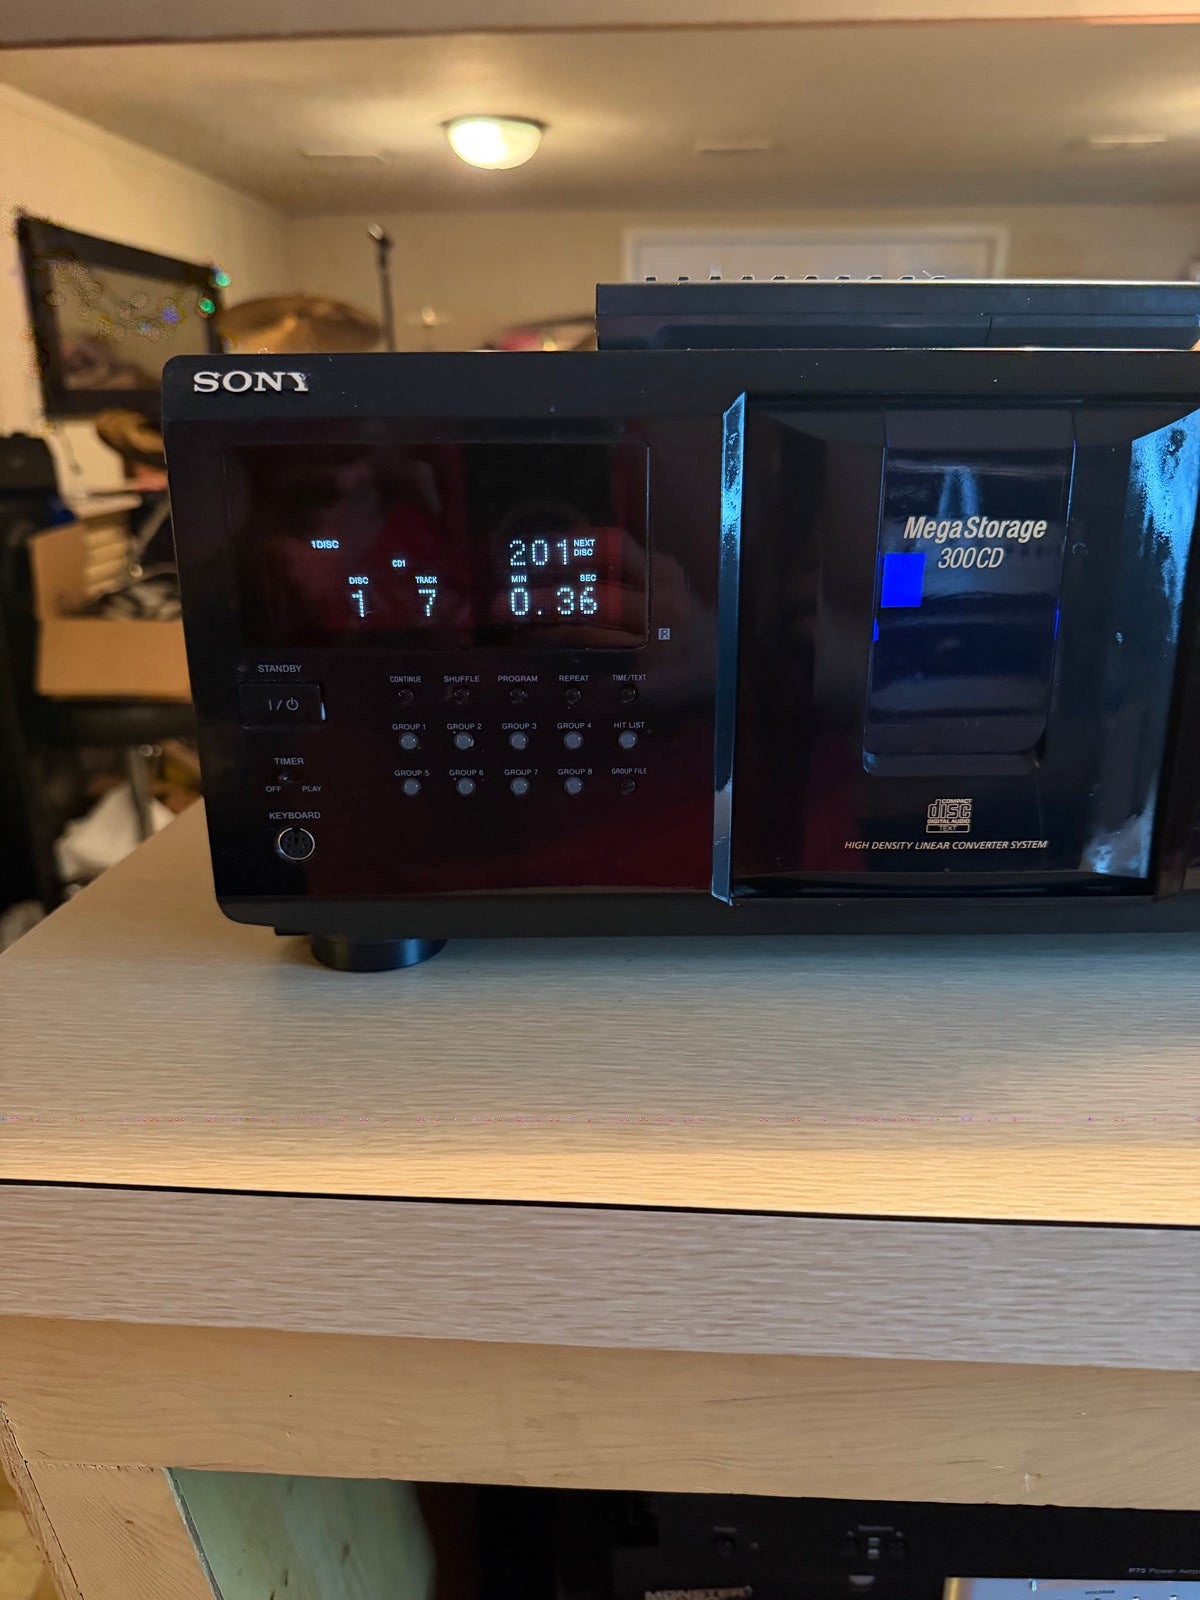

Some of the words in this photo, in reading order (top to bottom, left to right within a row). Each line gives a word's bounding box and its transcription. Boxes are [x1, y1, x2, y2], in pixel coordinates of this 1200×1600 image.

[193, 370, 309, 393] SONY
[573, 539, 596, 547] NEXT
[509, 539, 568, 566] 201
[573, 548, 593, 556] DISC
[391, 559, 406, 568] CD1
[348, 576, 369, 585] DISC
[414, 576, 438, 584] TRACK
[510, 575, 527, 583] MIN
[579, 573, 597, 582] SEC
[351, 589, 365, 618] 1
[418, 589, 436, 617] 7
[257, 664, 302, 673] STANDBY
[389, 675, 422, 683] CONTINUE
[443, 675, 481, 683] SHUFFLE
[558, 674, 590, 682] REPEAT
[501, 722, 530, 730] GROUP
[532, 722, 537, 730] 3
[613, 721, 627, 729] HIT
[628, 721, 645, 729] LIST
[274, 757, 304, 765] TIMER
[504, 768, 532, 776] GROUP
[265, 785, 282, 793] OFF
[927, 799, 972, 819] disc
[269, 811, 321, 820] KEYBOARD
[844, 841, 870, 850] HIGH
[871, 841, 913, 850] DENSITY
[914, 841, 950, 850] LINEAR
[951, 840, 1008, 850] CONVERTER
[1009, 840, 1048, 849] SYSTEM
